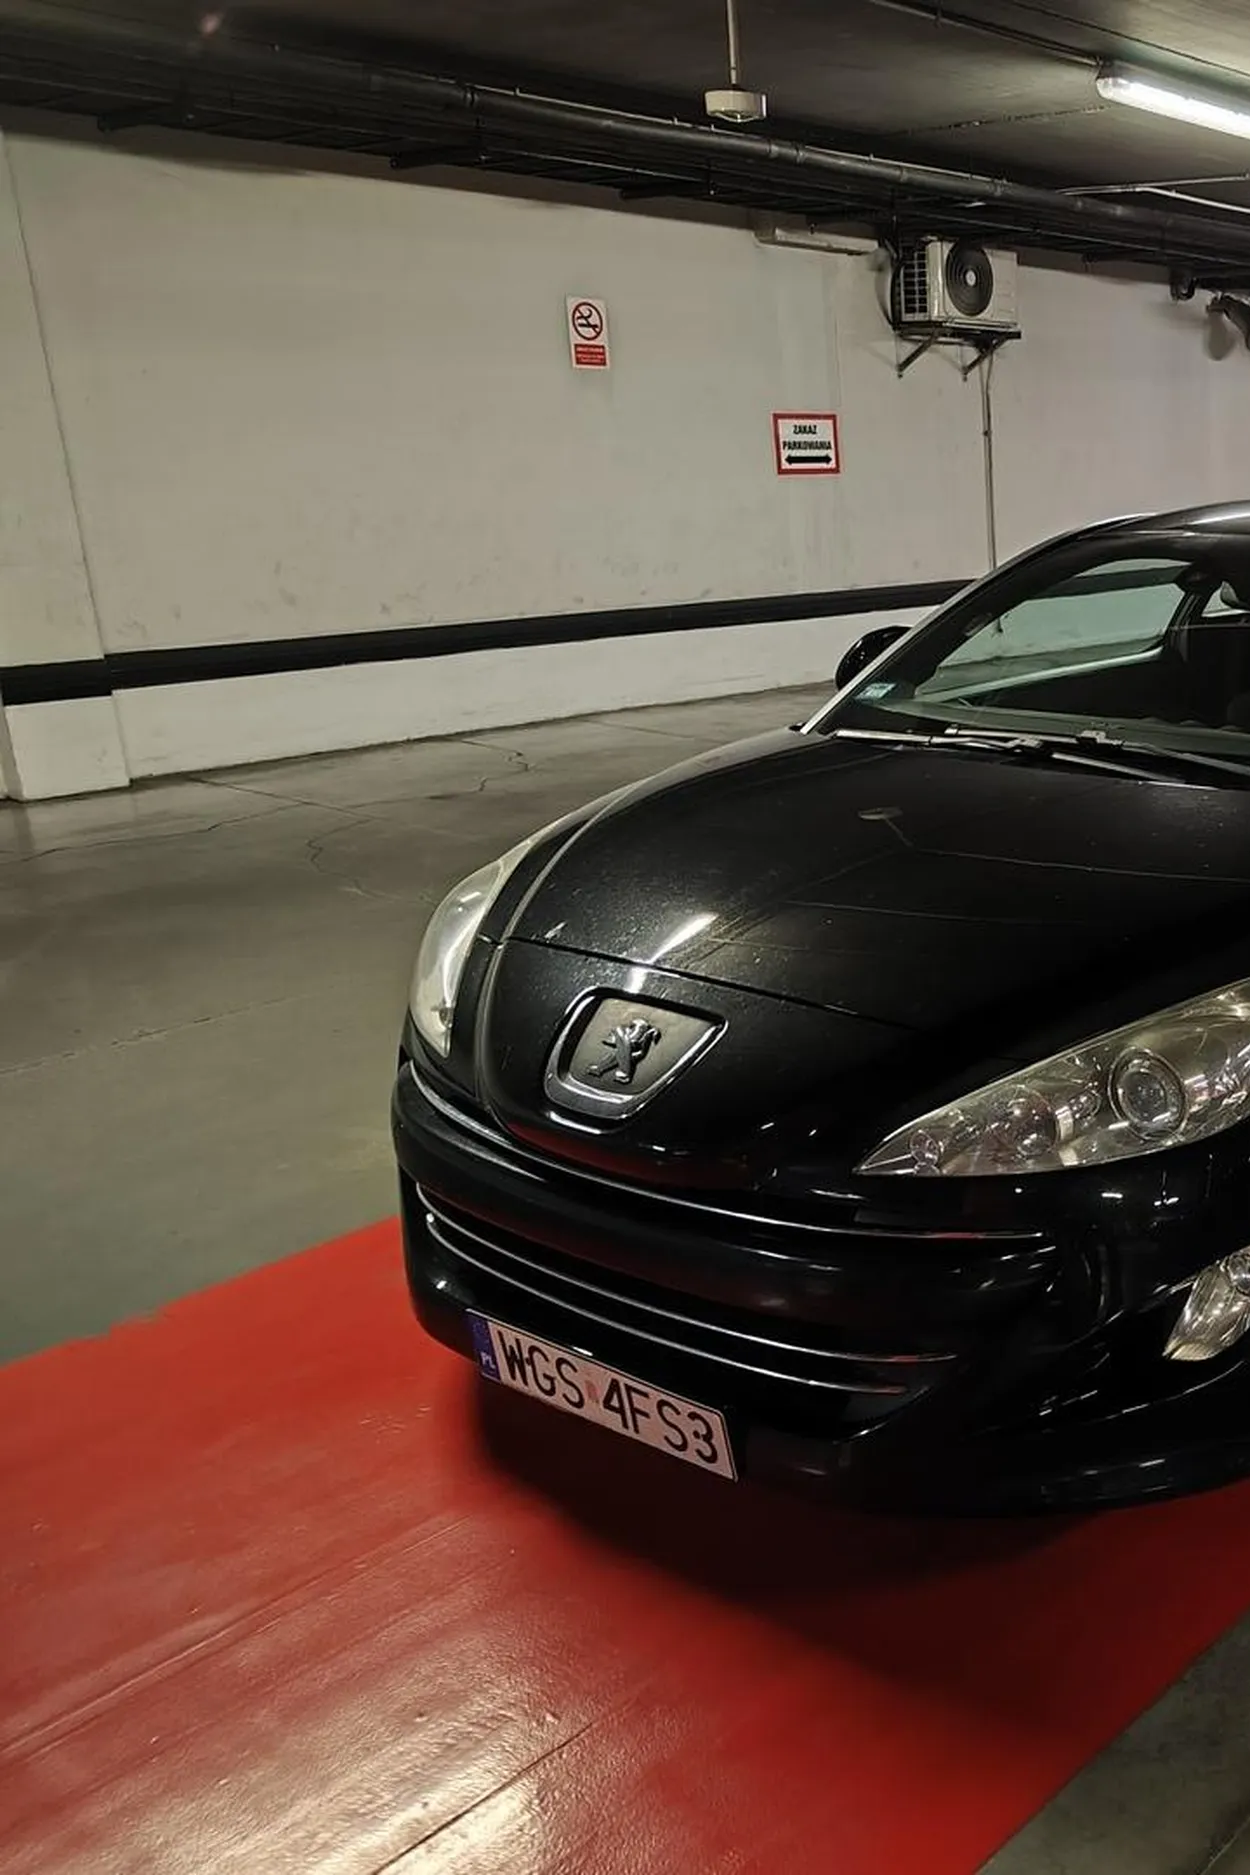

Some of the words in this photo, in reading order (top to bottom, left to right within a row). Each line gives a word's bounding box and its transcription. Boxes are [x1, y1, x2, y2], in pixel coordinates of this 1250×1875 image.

[792, 424, 817, 435] ZAKAZ
[480, 1351, 497, 1370] PL
[497, 1330, 585, 1409] WGS
[602, 1378, 718, 1465] 4FS3
